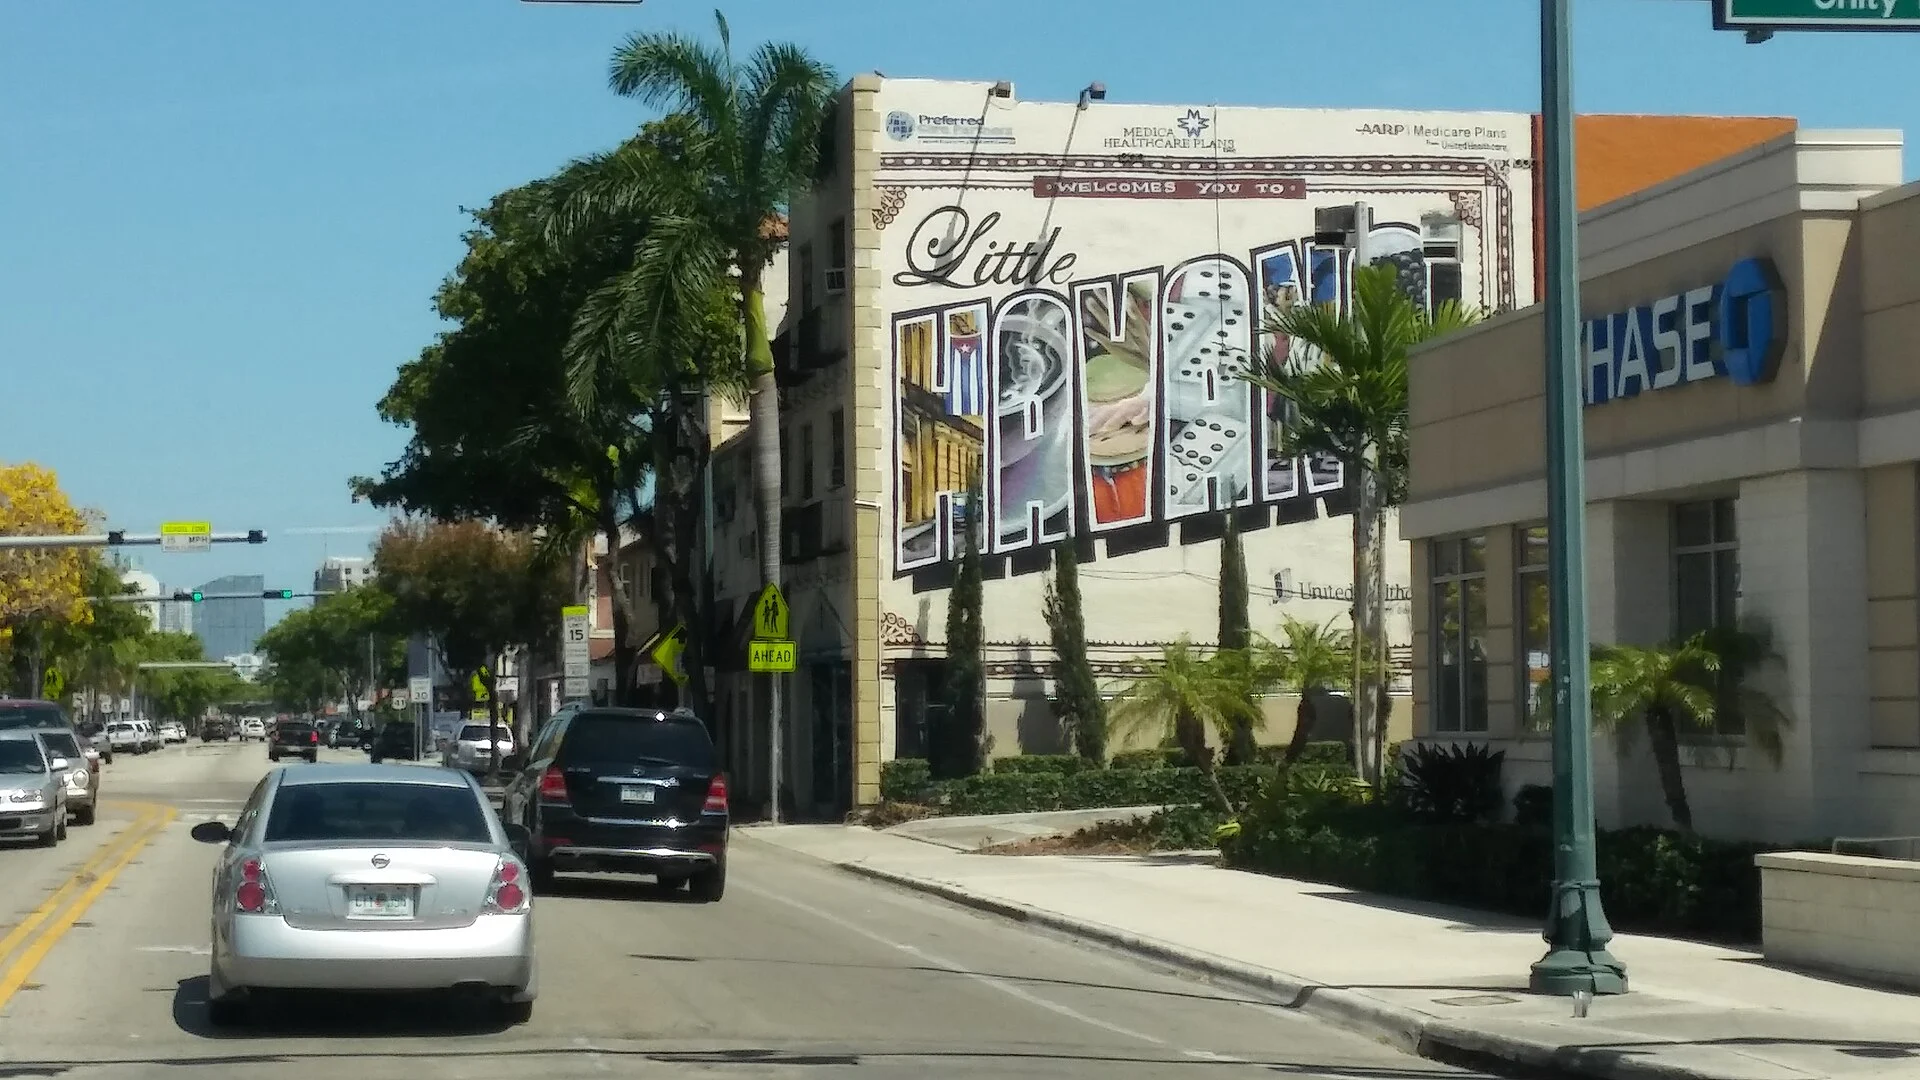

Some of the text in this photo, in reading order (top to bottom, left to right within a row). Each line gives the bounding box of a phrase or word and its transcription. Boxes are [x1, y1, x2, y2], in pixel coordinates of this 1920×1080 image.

[919, 115, 984, 126] Preferred
[1123, 127, 1174, 137] MEDICA
[1356, 123, 1507, 139] AARP Medicare Plans
[1103, 138, 1235, 149] HEALTHCARE PLANS
[1057, 181, 1285, 194] WELCOMES YOU TO
[893, 205, 1077, 289] Little
[1586, 285, 1716, 404] HASE
[892, 218, 1434, 580] HAVAN
[570, 629, 583, 641] 15
[753, 650, 791, 662] AHEAD
